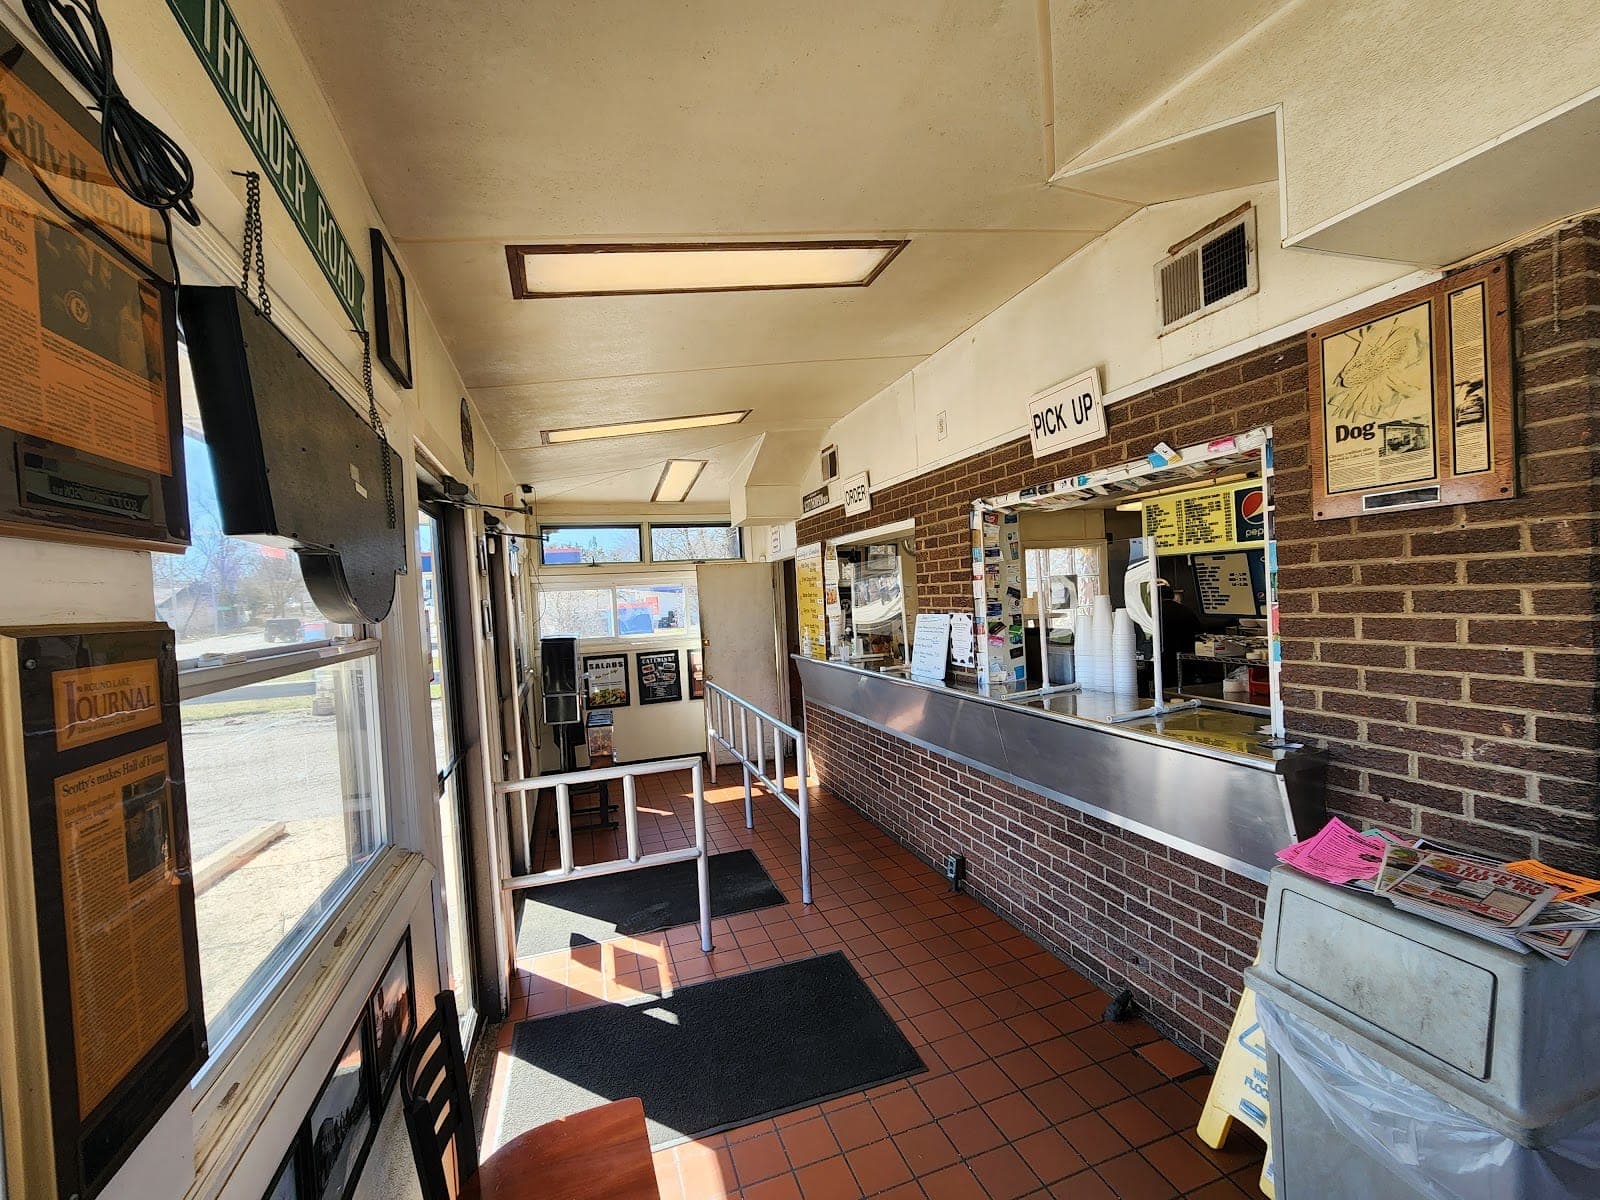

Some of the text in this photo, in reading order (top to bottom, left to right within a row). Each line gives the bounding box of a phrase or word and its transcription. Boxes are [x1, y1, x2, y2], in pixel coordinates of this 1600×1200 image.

[203, 0, 356, 307] THUNDER ROAD
[1032, 392, 1093, 440] PICK UP
[1335, 421, 1376, 443] Dog
[845, 484, 866, 506] ORDER
[1245, 528, 1264, 538] pep
[588, 662, 624, 670] SALADS
[62, 680, 157, 740] JOURNAL
[62, 775, 96, 798] Scotty's
[97, 768, 121, 785] makes
[1252, 1066, 1269, 1086] WE
